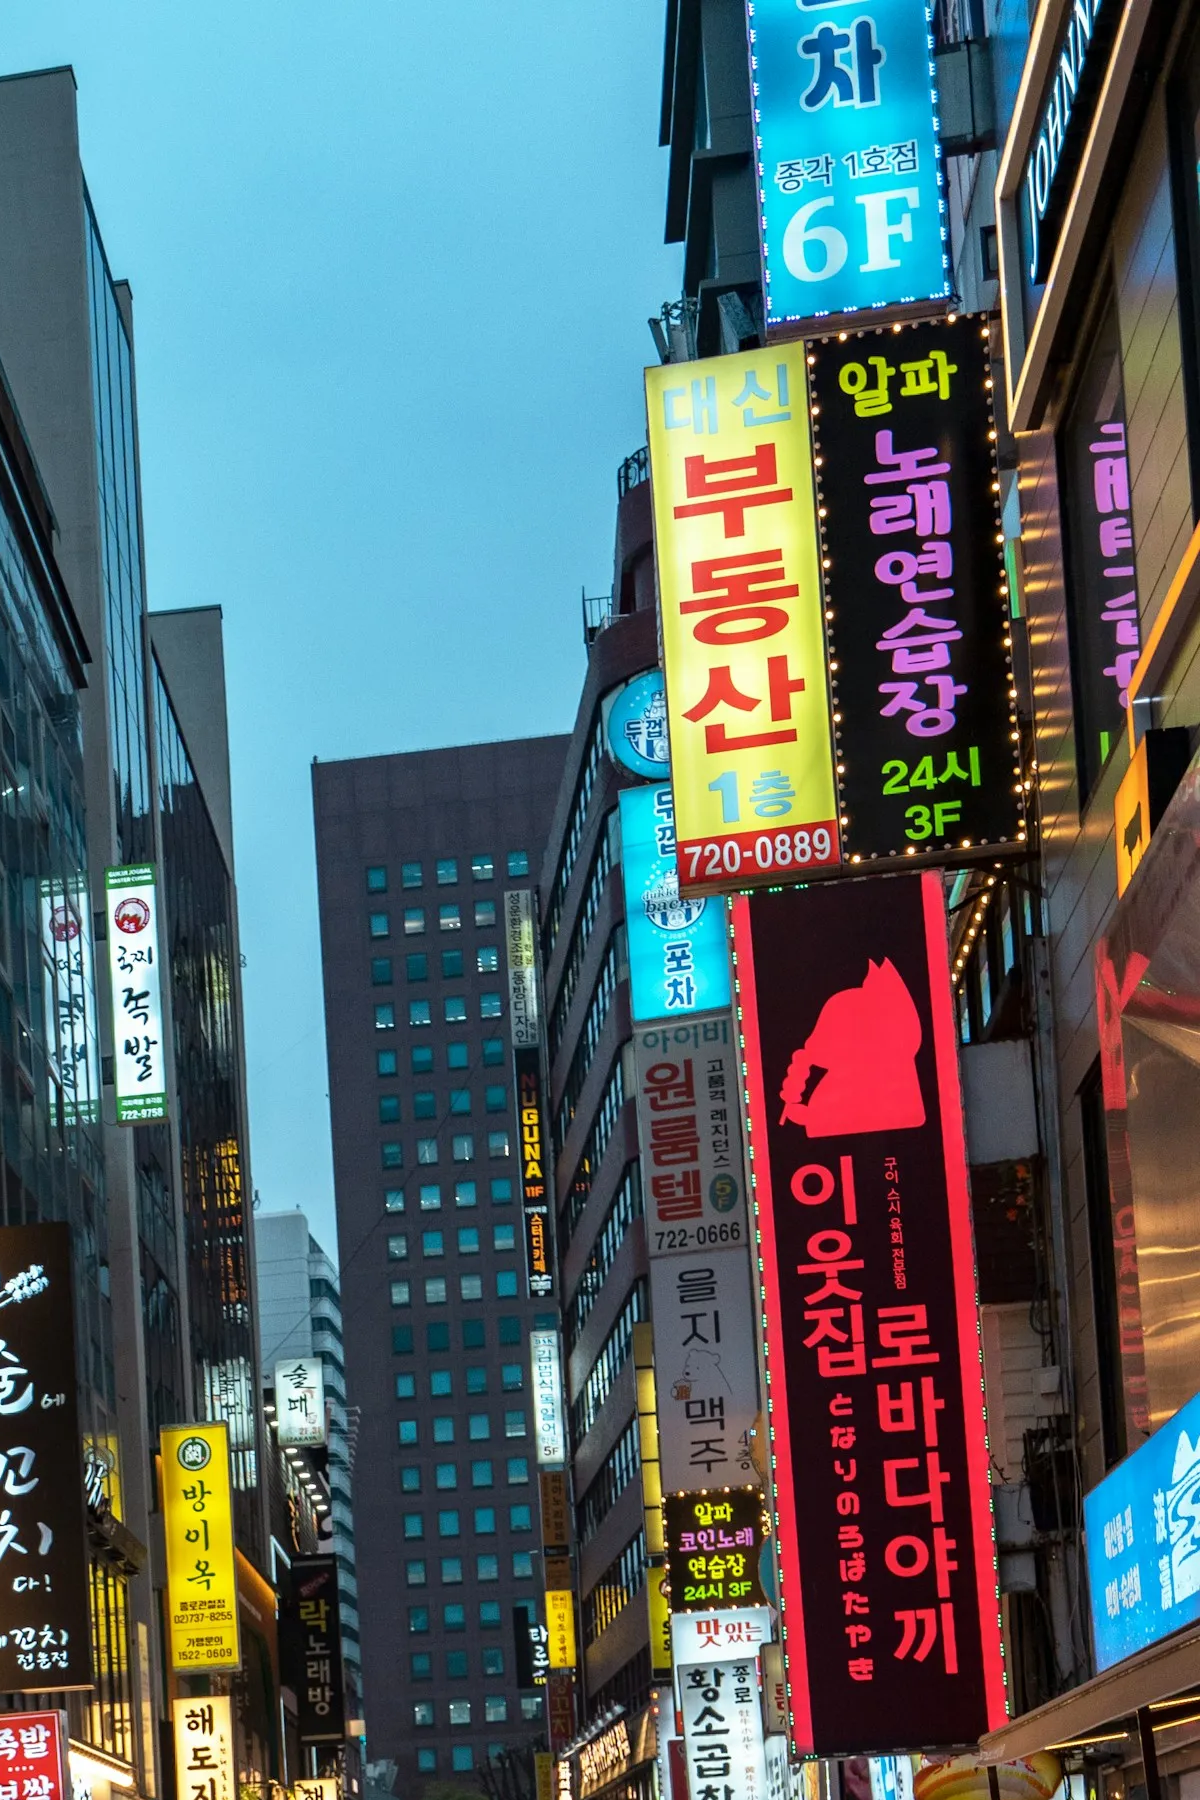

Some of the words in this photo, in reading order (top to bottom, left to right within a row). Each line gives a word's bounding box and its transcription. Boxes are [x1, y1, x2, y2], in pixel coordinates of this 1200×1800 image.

[796, 0, 886, 112] 차
[775, 155, 834, 194] 종각
[846, 141, 920, 182] 1호점
[781, 186, 921, 283] 6F
[662, 362, 793, 436] 대신
[837, 349, 959, 419] 알파
[671, 443, 806, 755] 부동산
[863, 430, 968, 738] 노래연습장
[707, 769, 797, 825] 1층
[880, 745, 982, 798] 24시
[903, 801, 962, 841] 3F
[684, 826, 833, 880] 720-0889
[663, 941, 697, 1010] 포차
[122, 986, 158, 1082] 족발
[642, 1021, 729, 1053] 아이비
[706, 1058, 726, 1103] 고품격
[121, 1107, 164, 1120] 722-9758
[522, 1072, 543, 1179] NUGUNA
[641, 1057, 704, 1223] 원룸텔
[709, 1109, 732, 1170] 레지던스
[883, 1157, 899, 1185] 구이
[654, 1222, 742, 1252] 722-0666
[789, 1154, 867, 1378] 이웃집
[694, 1502, 734, 1526] 알파
[871, 1304, 959, 1675] 로바다야끼
[181, 1479, 216, 1592] 방이옥
[678, 1526, 754, 1552] 코인노래
[828, 1392, 874, 1682] となりのろばたやき
[683, 1583, 723, 1601] 24시
[727, 1581, 752, 1597] 3F
[687, 1553, 746, 1580] 연습장
[173, 1611, 233, 1625] 02)737-8255
[186, 1635, 224, 1648] 가맹문의
[695, 1618, 763, 1649] 맛있는
[177, 1648, 233, 1661] 1522-0609
[305, 1634, 334, 1716] 노래방
[731, 1664, 753, 1704] 종로
